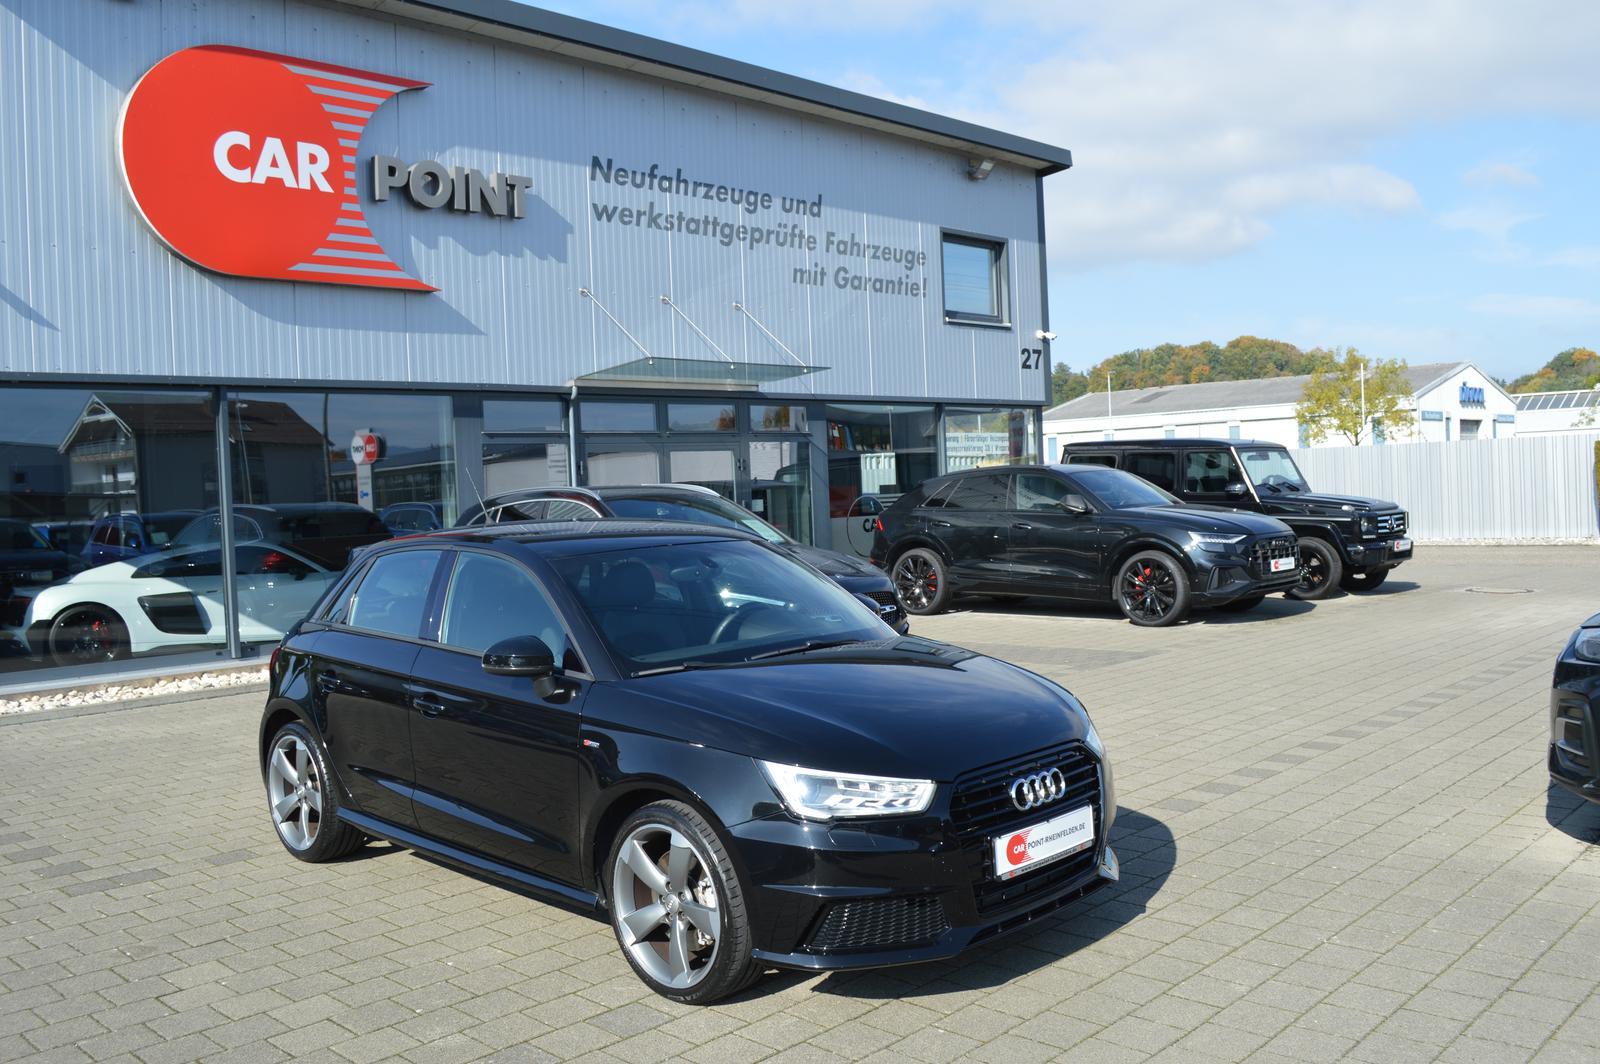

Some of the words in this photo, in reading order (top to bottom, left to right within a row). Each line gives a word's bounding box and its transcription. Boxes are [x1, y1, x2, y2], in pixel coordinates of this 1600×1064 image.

[213, 131, 335, 193] CAR
[370, 154, 533, 219] POINT
[590, 155, 773, 214] Neufahrzeuge
[781, 194, 823, 218] und
[592, 202, 817, 250] werkstattgeprüfte
[825, 231, 927, 271] Fahrzeuge
[792, 264, 827, 287] mit
[834, 266, 927, 298] Garantie!
[1021, 348, 1042, 370] 27
[1013, 843, 1025, 853] CAR
[1028, 823, 1086, 849] POINT-RHEINFELDEN.DE
